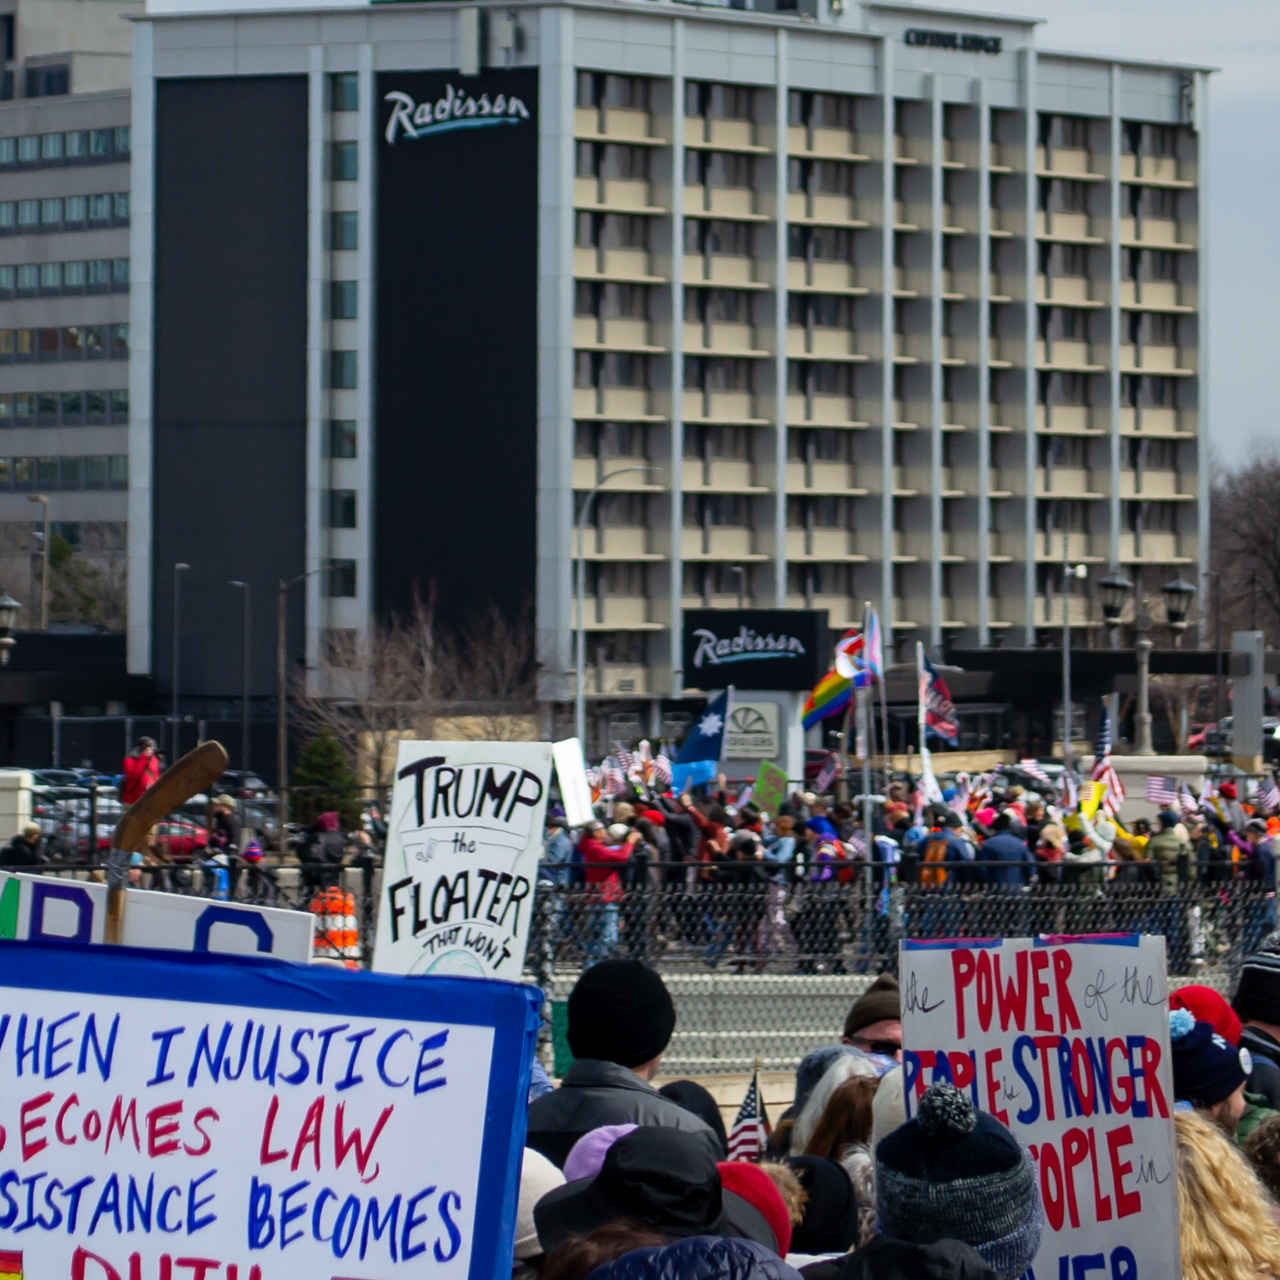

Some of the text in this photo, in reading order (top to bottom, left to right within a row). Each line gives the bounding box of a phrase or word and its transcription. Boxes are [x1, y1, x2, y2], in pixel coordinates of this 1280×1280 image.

[384, 83, 530, 146] Radisson
[692, 625, 806, 668] Radisson
[398, 756, 543, 828] TRUMP
[452, 832, 477, 854] the
[387, 868, 530, 943] FLOATER
[422, 926, 463, 955] THAT
[902, 948, 1169, 1040] the POWER of the
[146, 1019, 451, 1096] INJUSTICE
[1002, 1076, 1020, 1101] is
[1012, 1035, 1170, 1125] STRONGER
[259, 1094, 395, 1185] LAW,
[1026, 1124, 1170, 1232] OPLE in
[247, 1175, 463, 1265] BECOMES
